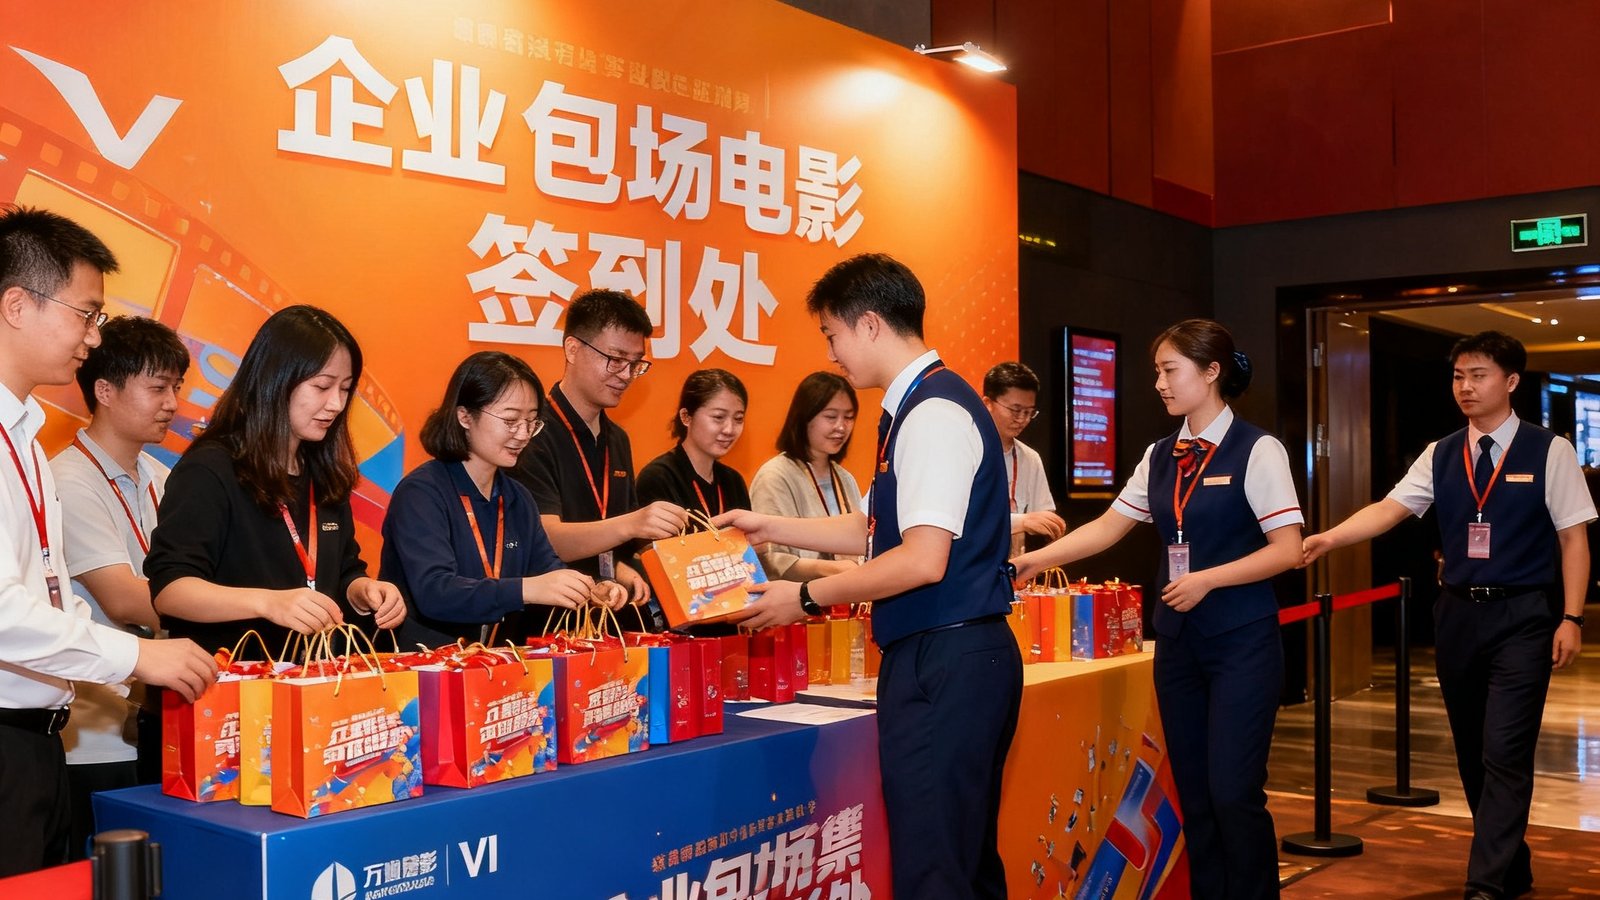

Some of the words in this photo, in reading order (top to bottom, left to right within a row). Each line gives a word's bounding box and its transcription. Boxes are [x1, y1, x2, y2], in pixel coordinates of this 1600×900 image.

[277, 34, 865, 248] 企业包场电影
[465, 212, 780, 367] 签到处
